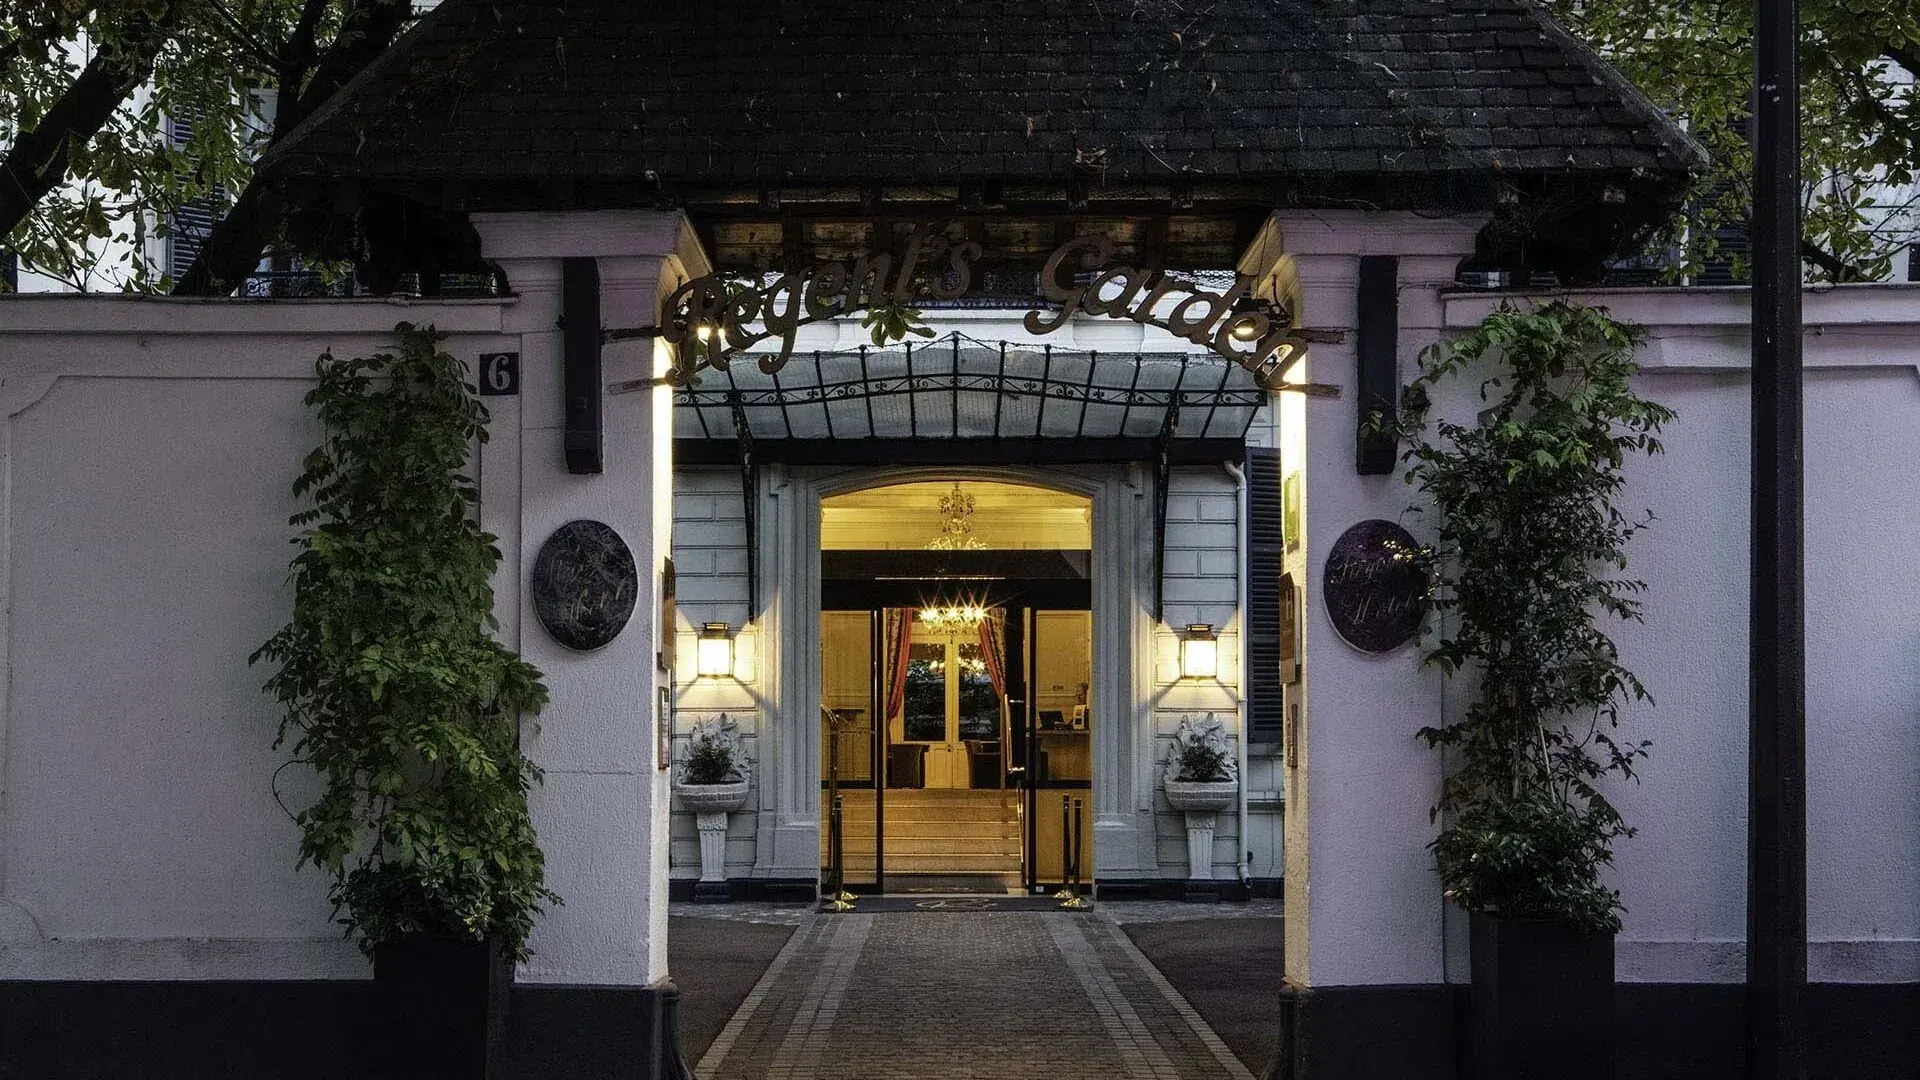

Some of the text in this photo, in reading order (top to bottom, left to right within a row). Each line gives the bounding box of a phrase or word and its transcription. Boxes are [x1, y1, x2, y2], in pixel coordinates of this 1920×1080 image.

[661, 222, 1308, 389] Regent's Garden
[488, 356, 511, 390] 6
